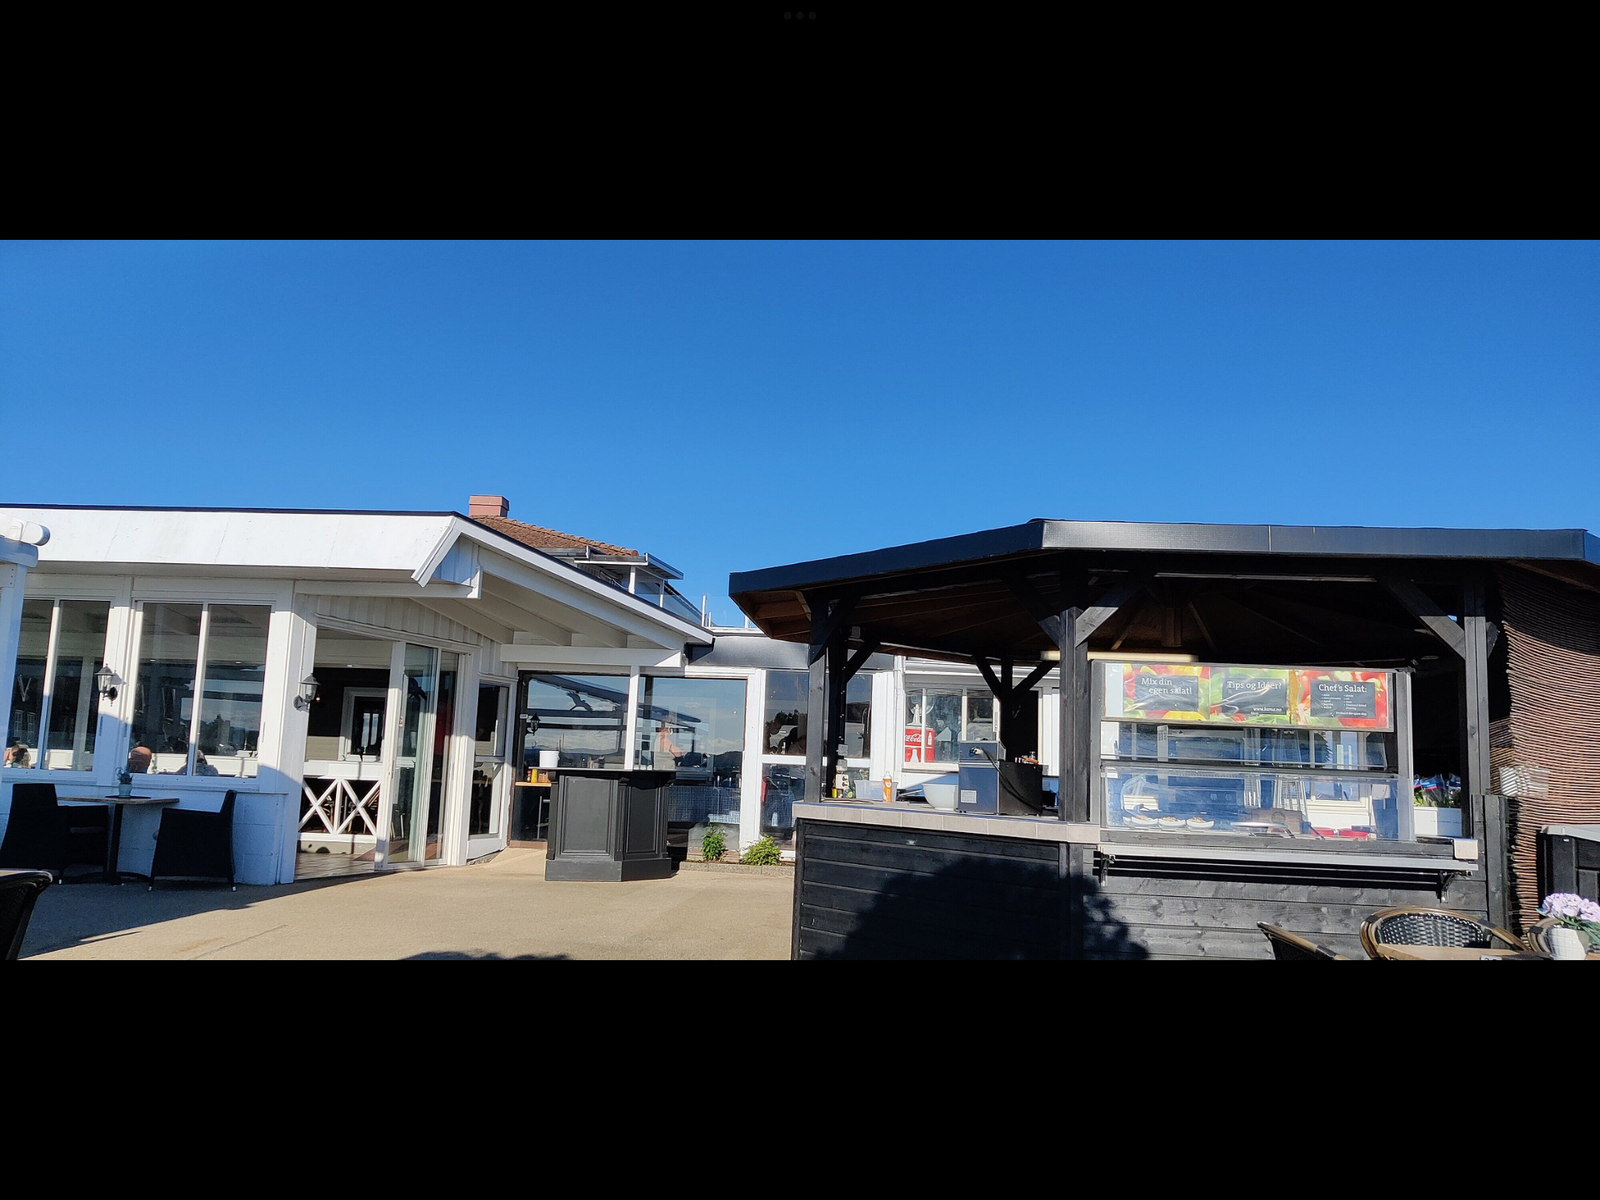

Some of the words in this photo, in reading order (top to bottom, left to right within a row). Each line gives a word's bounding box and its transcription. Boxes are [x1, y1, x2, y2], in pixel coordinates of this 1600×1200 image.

[1141, 677, 1158, 686] Mix
[1159, 677, 1173, 686] din
[1227, 680, 1245, 690] Tips
[1246, 682, 1256, 690] og
[1148, 686, 1169, 696] egen
[1318, 683, 1343, 692] Chef's
[1344, 684, 1368, 693] Salat:
